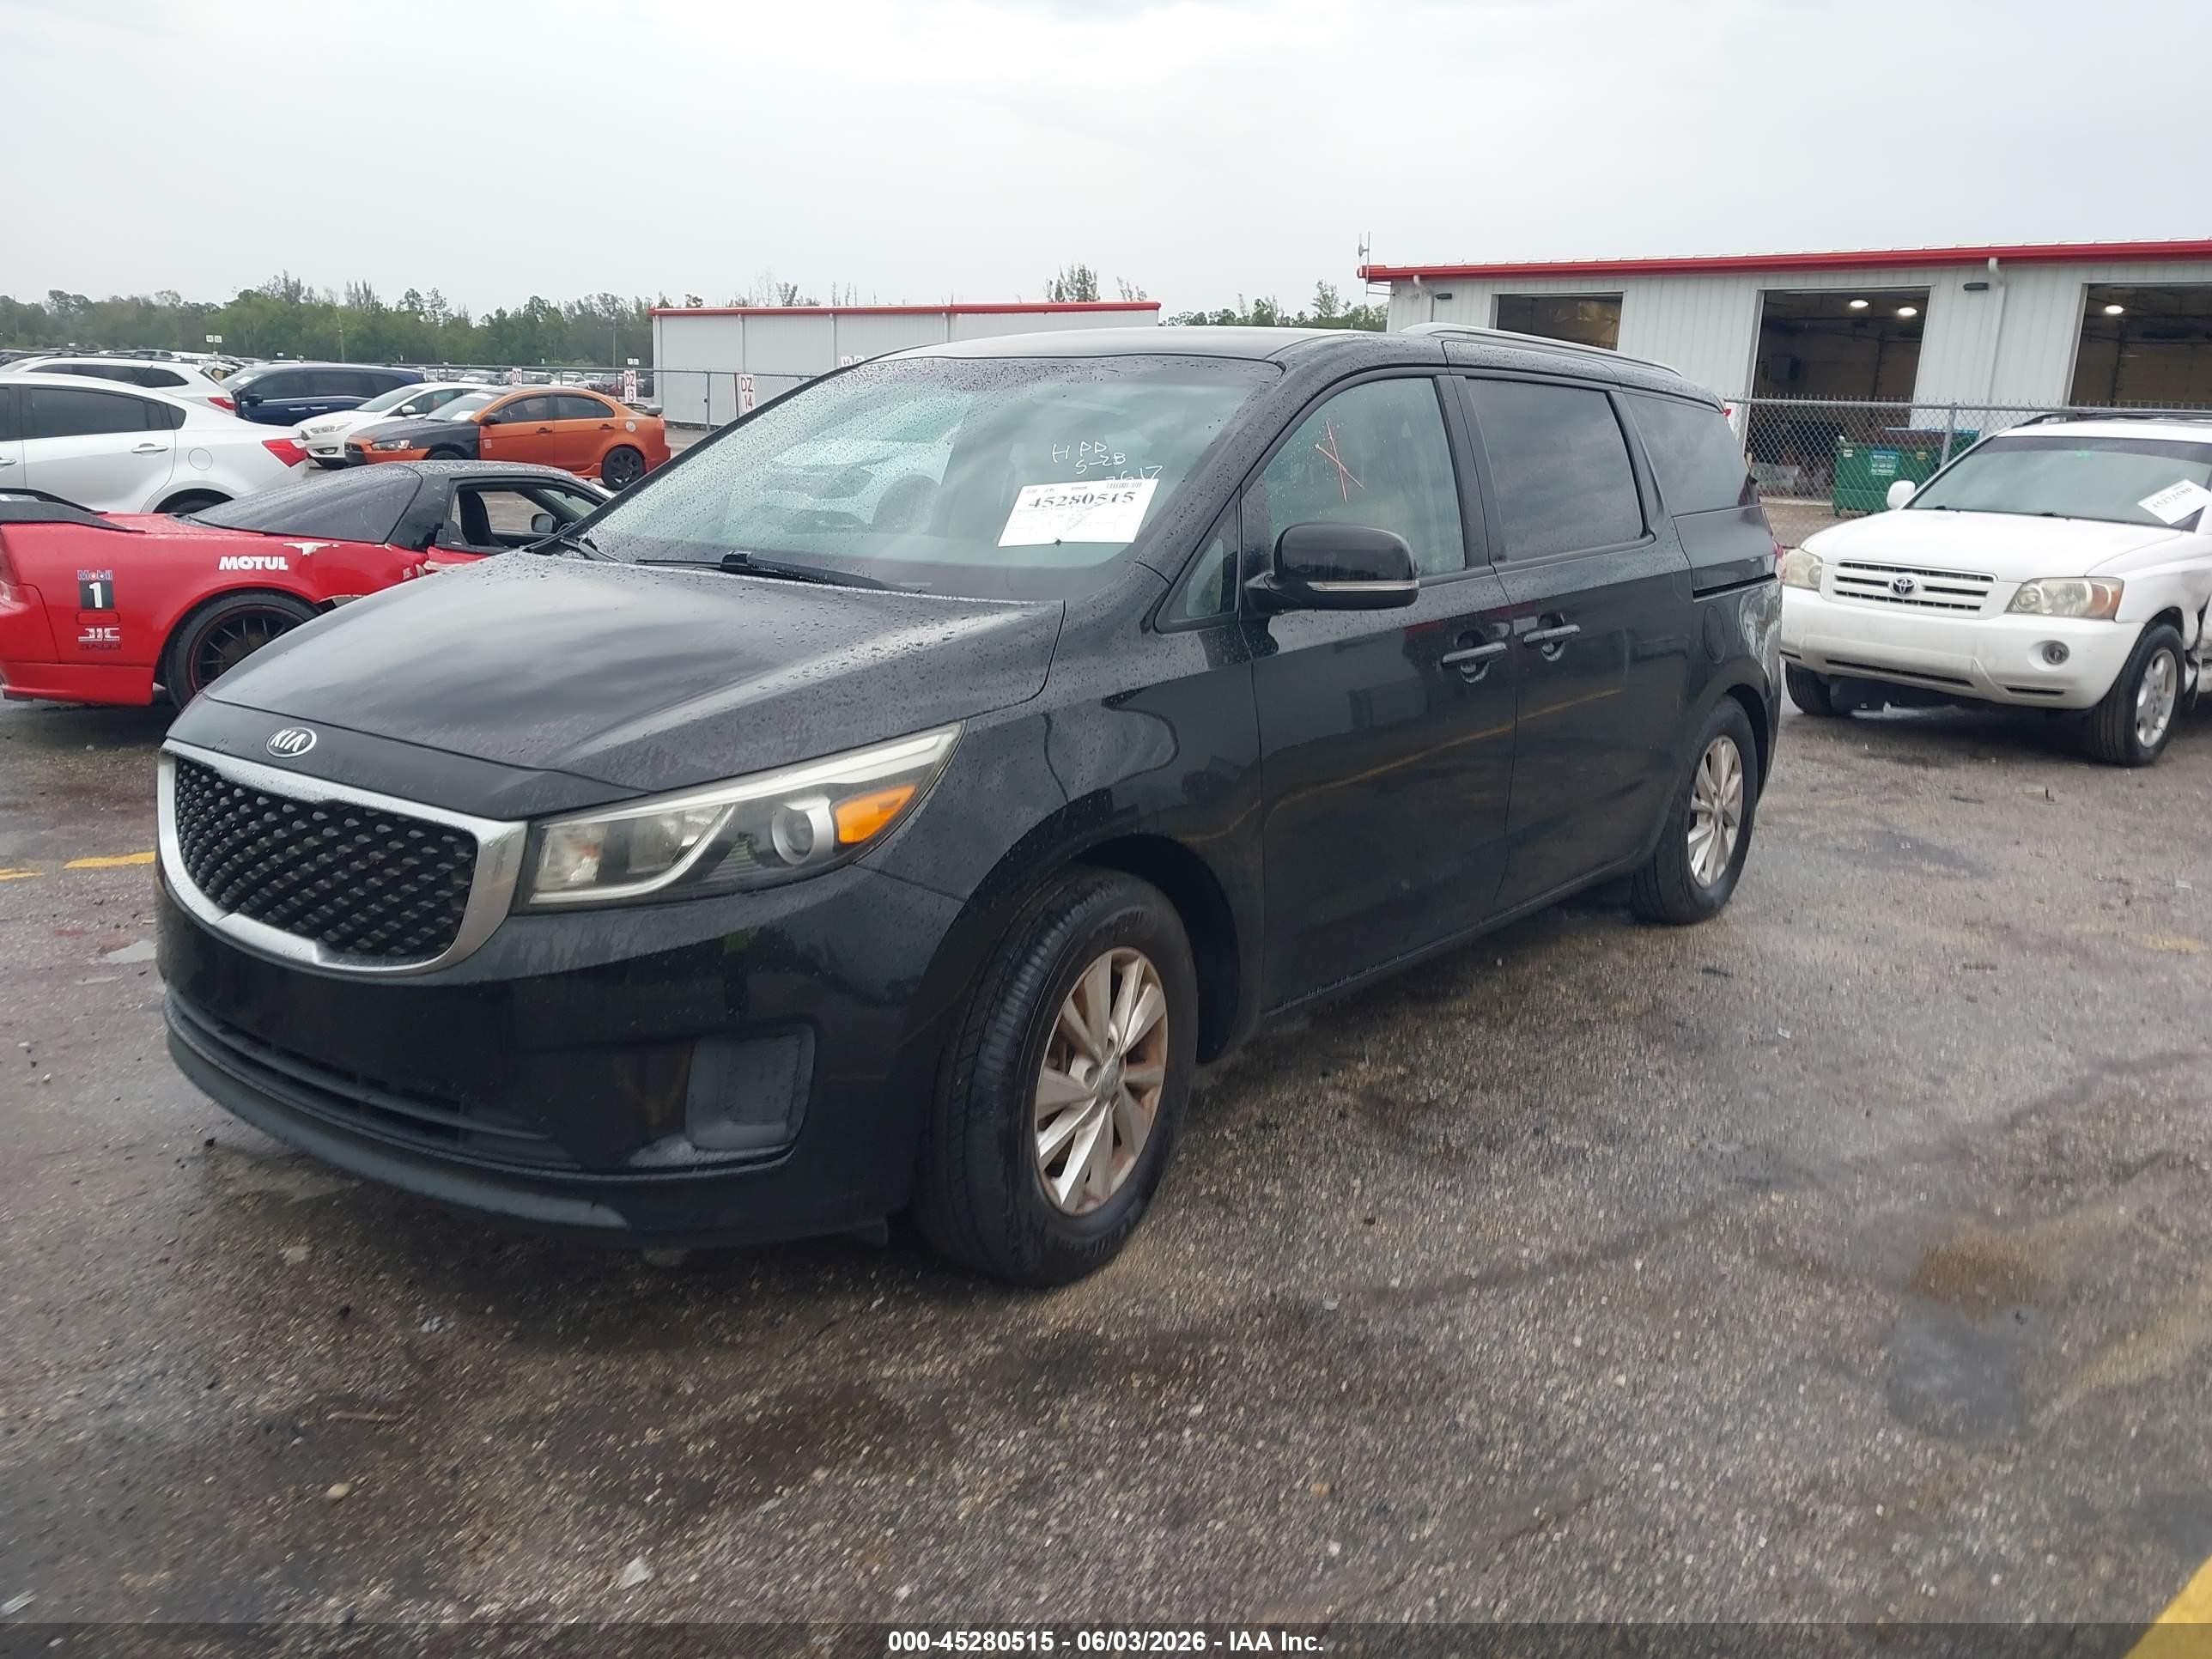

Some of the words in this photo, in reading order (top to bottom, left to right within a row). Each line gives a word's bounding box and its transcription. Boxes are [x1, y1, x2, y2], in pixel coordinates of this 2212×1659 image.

[513, 370, 521, 383] DZ
[626, 373, 635, 386] DZ
[740, 377, 754, 392] DZ
[627, 389, 635, 402] 13
[744, 394, 753, 410] 14
[1028, 491, 1136, 508] 45280515
[218, 556, 289, 571] MOTUL
[77, 569, 113, 581] Mobil
[88, 581, 103, 609] 1
